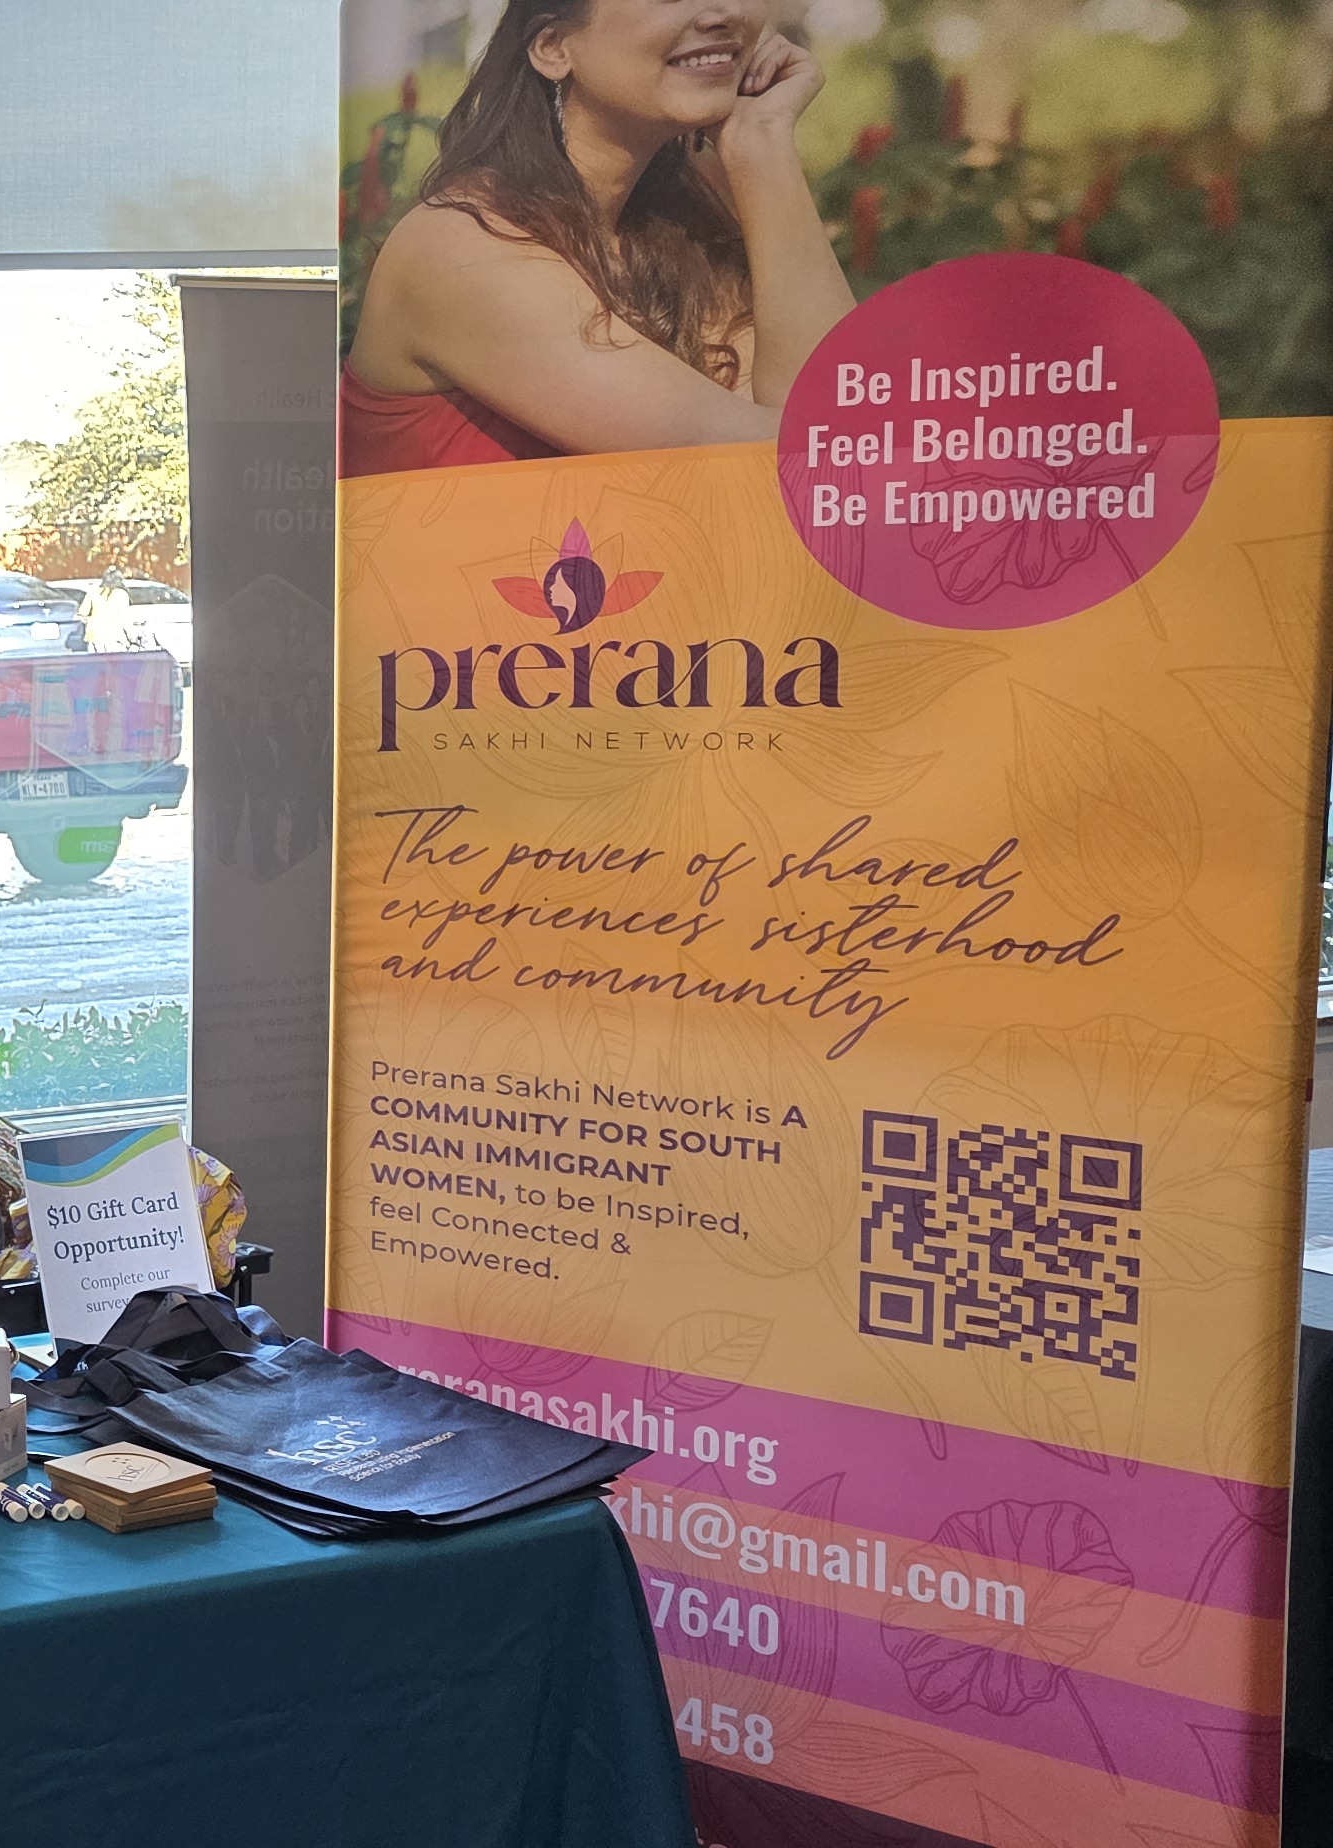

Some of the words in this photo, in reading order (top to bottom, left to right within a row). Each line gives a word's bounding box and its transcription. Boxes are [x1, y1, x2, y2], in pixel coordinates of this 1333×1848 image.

[837, 362, 892, 408] Be
[909, 345, 1117, 406] Inspired.
[808, 422, 894, 468] Feel
[912, 409, 1147, 466] Belonged.
[812, 483, 867, 528] Be
[885, 473, 1156, 533] Empowered
[377, 627, 844, 752] prerana
[434, 731, 547, 752] SAKHI
[576, 731, 786, 752] NETWORK
[375, 805, 488, 886] The
[484, 844, 664, 898] power
[687, 841, 757, 909] of
[769, 814, 1021, 893] shared
[381, 892, 726, 949] experiences
[751, 890, 1126, 970] sisterhood
[380, 937, 502, 987] and
[514, 958, 909, 1061] community
[370, 1060, 486, 1097] Prerana
[495, 1071, 583, 1106] Sakhi
[592, 1084, 734, 1121] Network
[744, 1099, 771, 1125] is
[781, 1104, 809, 1129] A
[370, 1096, 568, 1137] COMMUNITY
[578, 1119, 649, 1148] FOR
[659, 1128, 782, 1165] SOUTH
[370, 1131, 466, 1160] ASIAN
[474, 1142, 671, 1187] IMMIGRANT
[46, 1203, 82, 1231] $10
[87, 1197, 126, 1222] Gift
[131, 1191, 180, 1216] Card
[369, 1197, 423, 1223] feel
[431, 1205, 600, 1252] Connected
[609, 1231, 632, 1257] &
[370, 1164, 506, 1206] WOMEN,
[515, 1181, 548, 1206] to
[556, 1184, 596, 1212] be
[605, 1192, 750, 1244] Inspired,
[53, 1225, 186, 1263] Opportunity!
[370, 1232, 559, 1282] Empowered.
[80, 1270, 145, 1292] Complete
[147, 1268, 171, 1284] our
[265, 1431, 376, 1465] hsc
[381, 1361, 779, 1486] ranasakhi.org
[106, 1465, 144, 1482] hsc
[650, 1579, 779, 1655] 7640
[676, 1697, 774, 1765] 458
